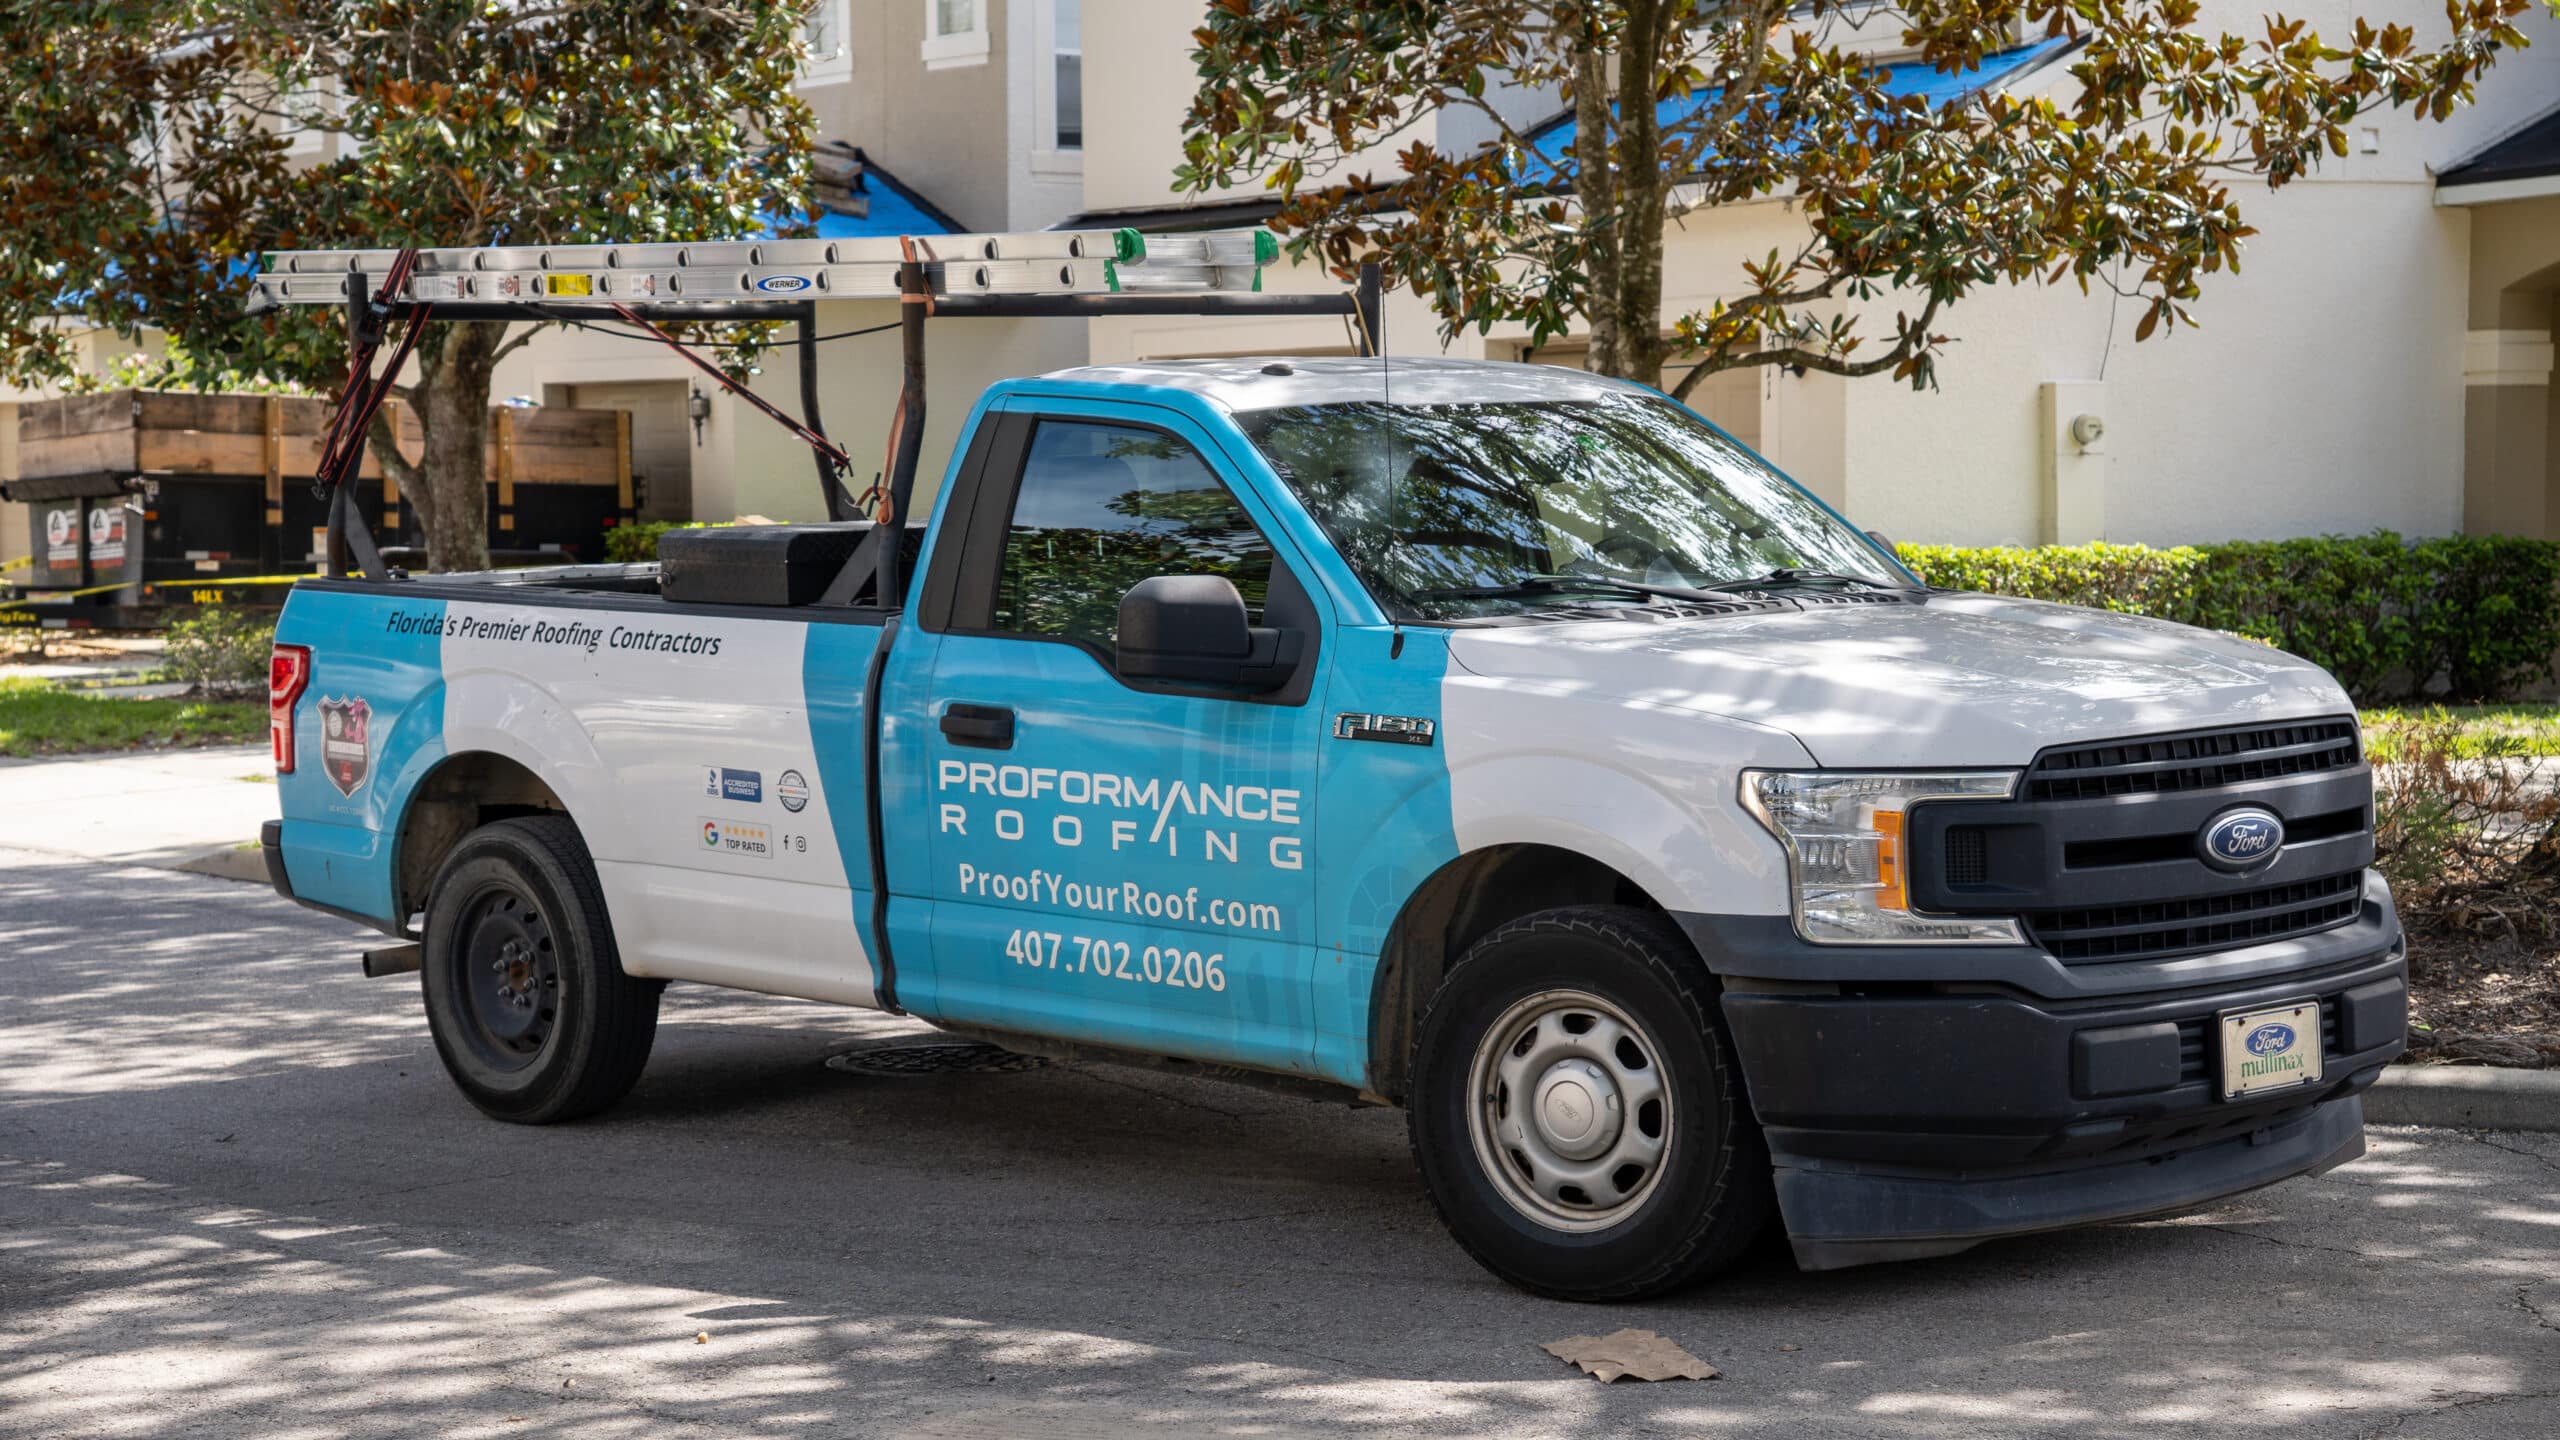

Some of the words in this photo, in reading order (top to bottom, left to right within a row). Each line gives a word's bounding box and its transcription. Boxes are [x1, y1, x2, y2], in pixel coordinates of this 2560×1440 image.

[768, 280, 800, 288] WERNER
[386, 611, 457, 637] Florida's
[459, 616, 530, 642] Premier
[532, 621, 602, 653] Roofing
[609, 626, 722, 656] Contractors
[939, 760, 1301, 842] PROFORMANCE
[725, 839, 740, 849] TOP
[742, 841, 766, 853] RATED
[940, 804, 1303, 870] ROOFING
[2228, 823, 2268, 853] Ford
[959, 863, 1281, 931] ProofYourRoof.com
[1005, 929, 1226, 992] 407.702.0206
[2256, 1028, 2286, 1051] Ford
[2241, 1050, 2304, 1078] mullinax
